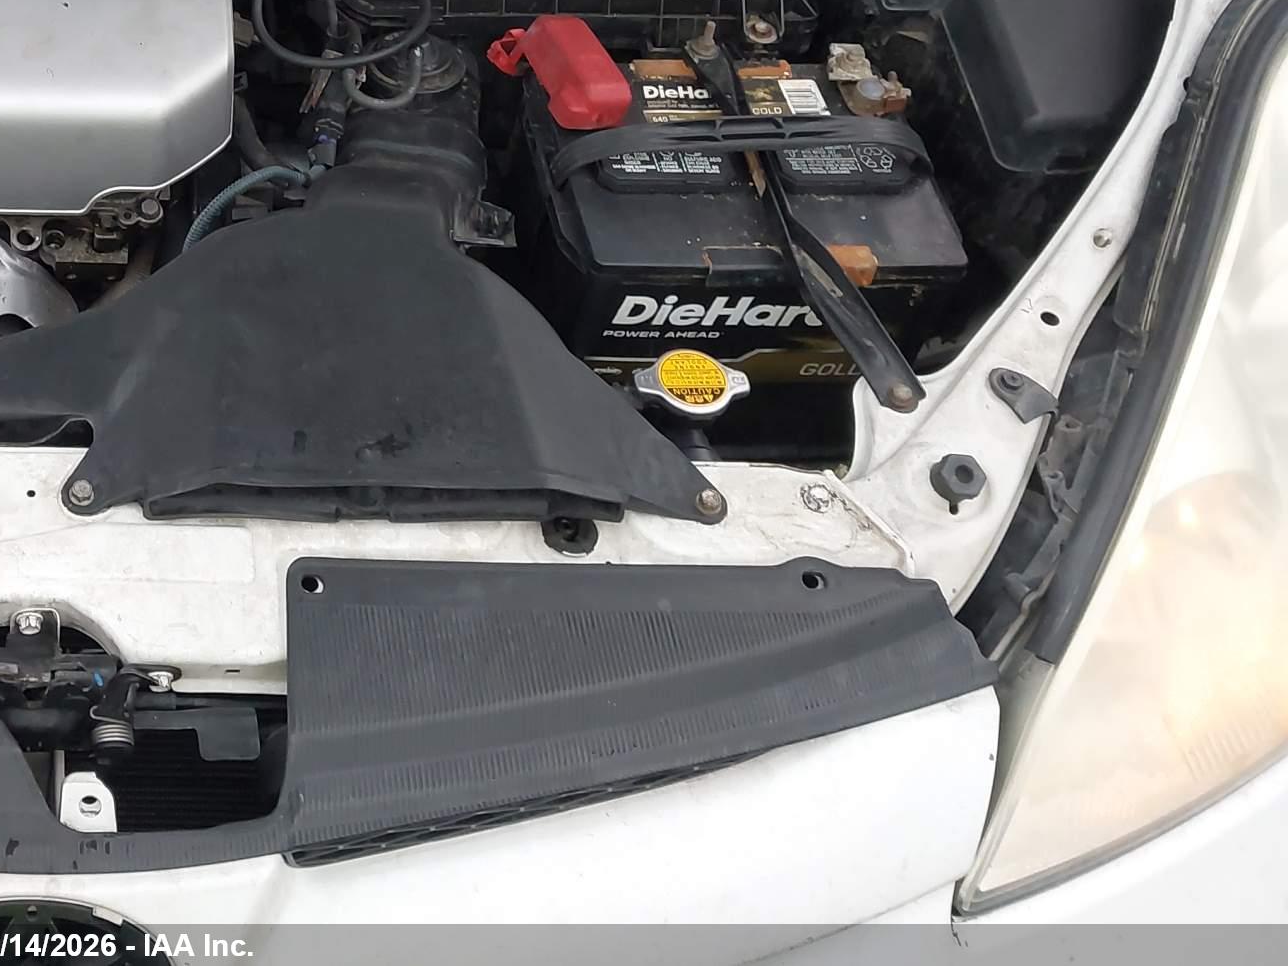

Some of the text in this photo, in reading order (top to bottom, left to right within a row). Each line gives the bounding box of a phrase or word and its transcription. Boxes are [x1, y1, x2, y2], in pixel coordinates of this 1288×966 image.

[642, 84, 710, 100] DieHa
[752, 106, 782, 115] GOLD
[603, 330, 720, 339] POWER AHEAD
[672, 387, 721, 395] CAUTION
